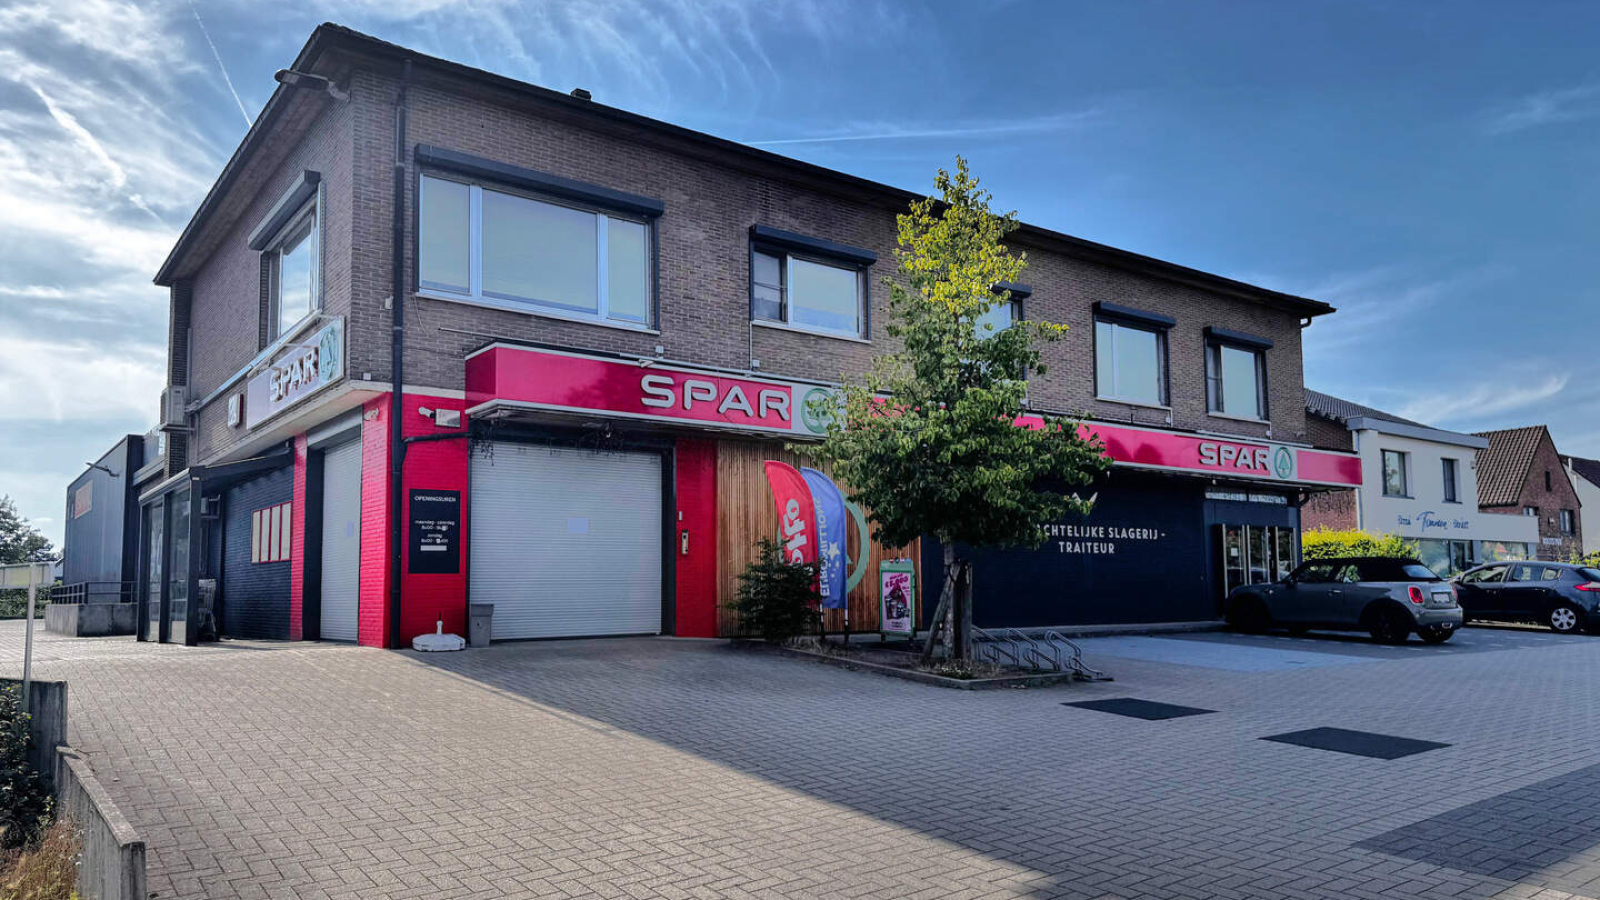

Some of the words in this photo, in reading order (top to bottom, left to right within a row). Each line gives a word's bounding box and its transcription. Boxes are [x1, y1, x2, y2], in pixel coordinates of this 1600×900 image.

[269, 347, 319, 403] SPAR
[641, 374, 790, 421] SPAR
[1199, 442, 1270, 471] SPAR
[1037, 523, 1105, 538] CHTELIJKE
[1108, 527, 1158, 540] SLAGERIJ
[1059, 541, 1115, 554] TRAITEUR
